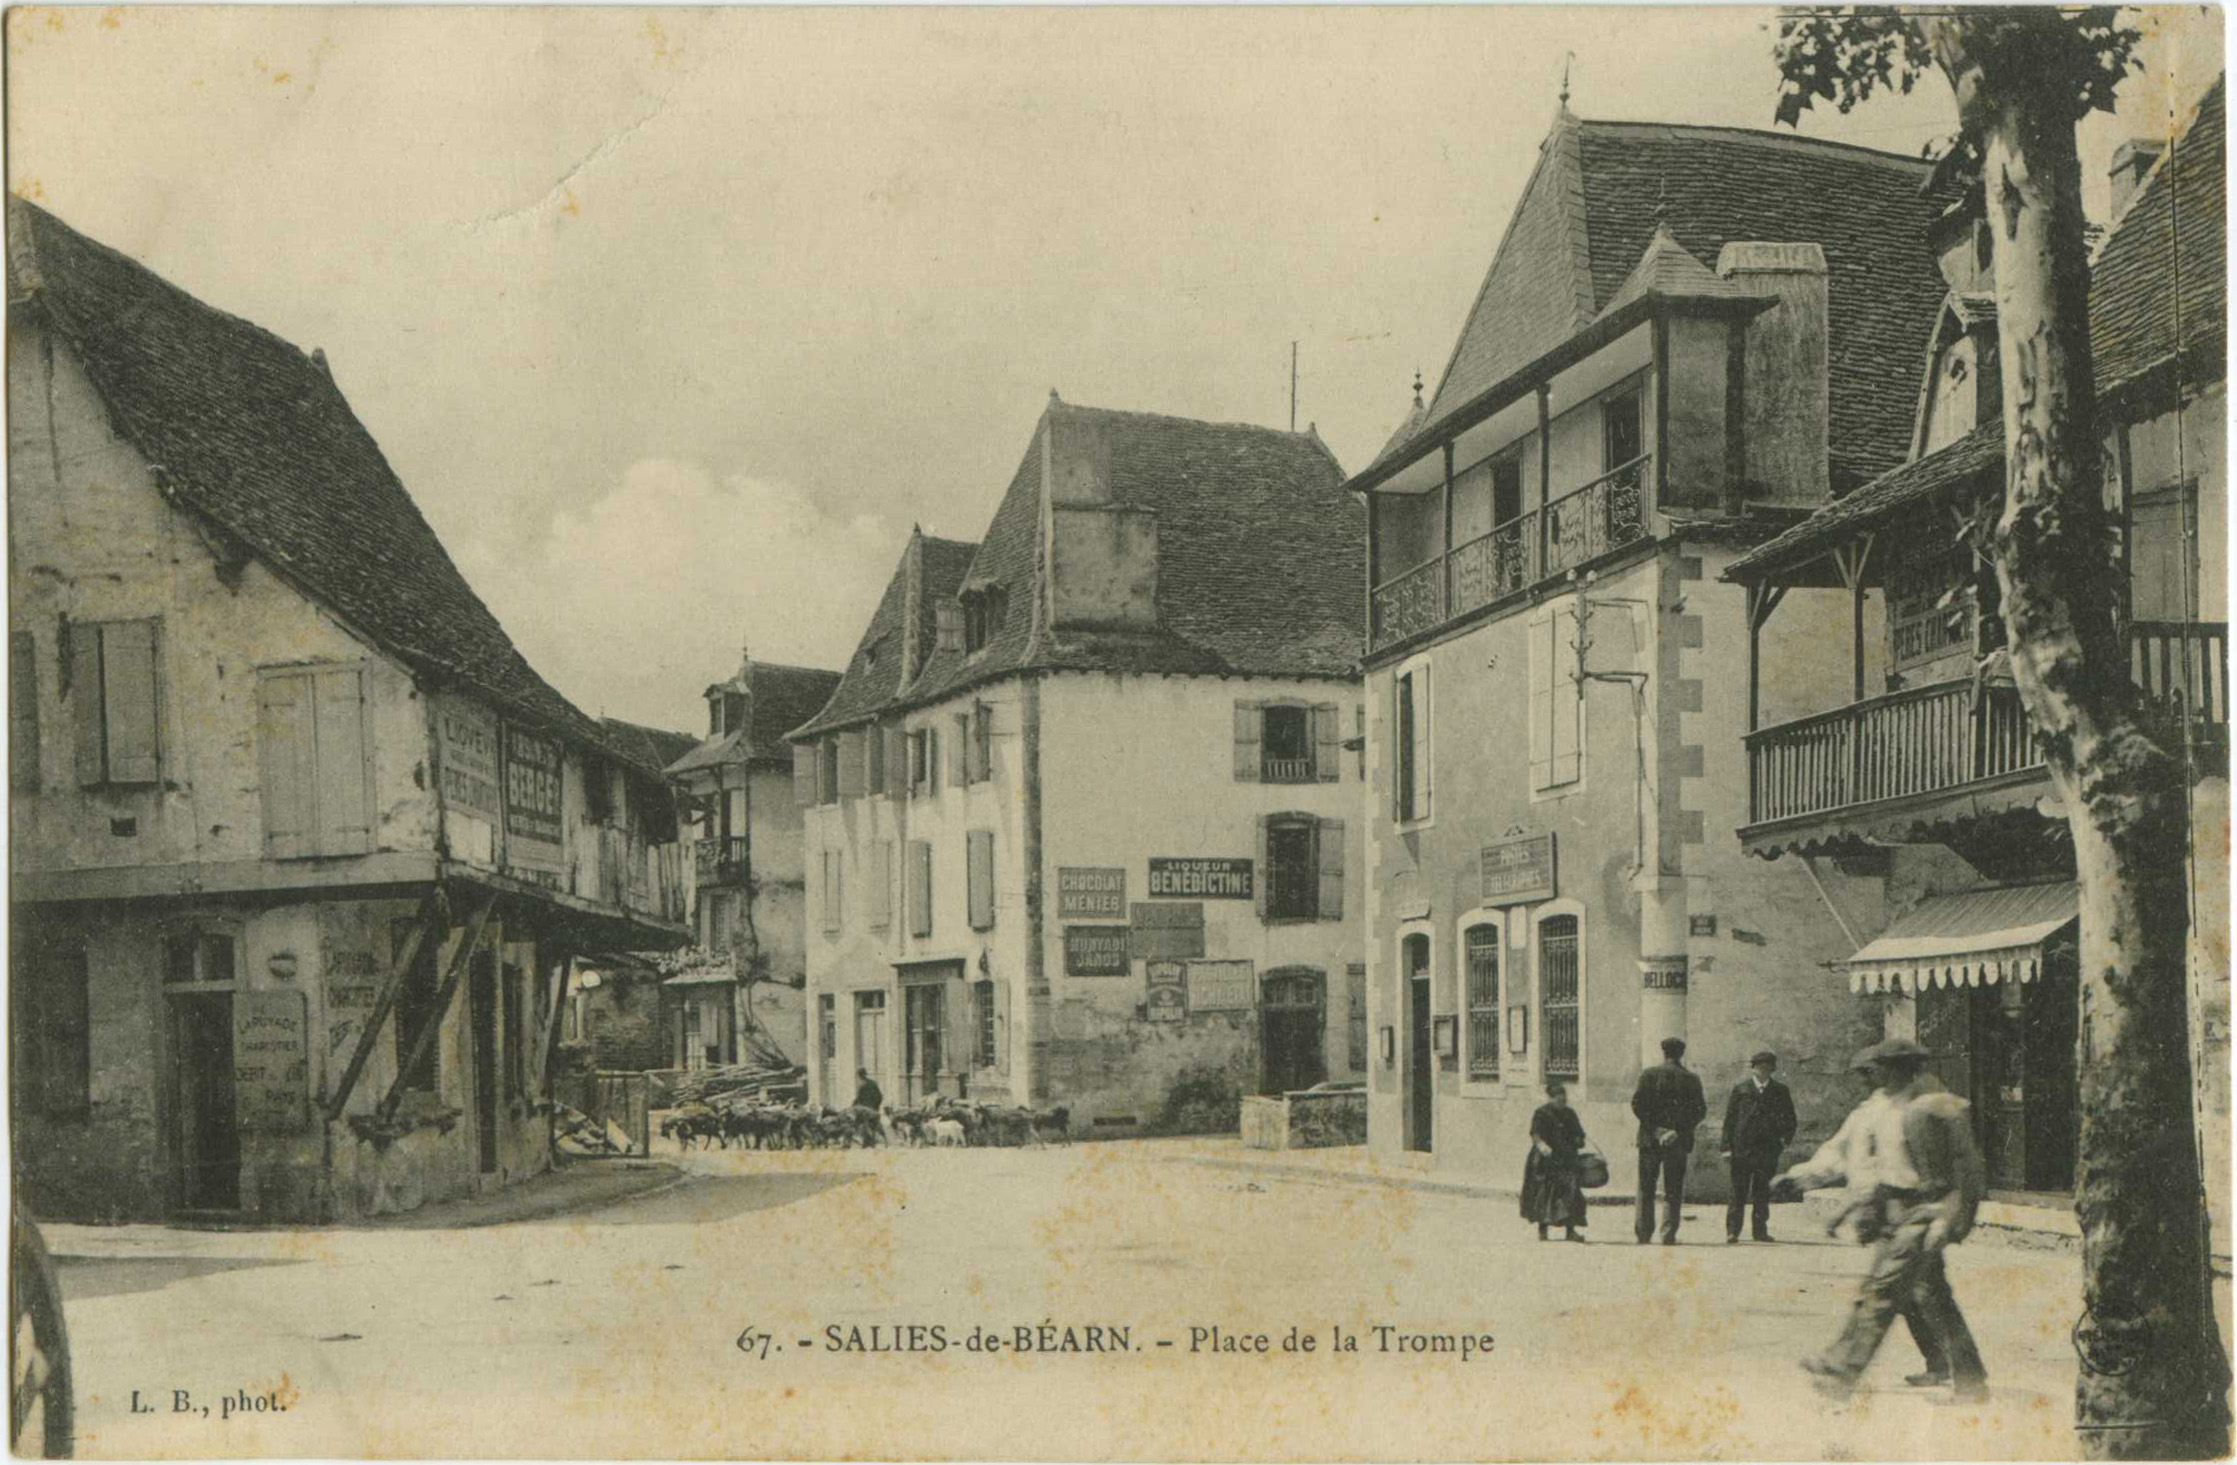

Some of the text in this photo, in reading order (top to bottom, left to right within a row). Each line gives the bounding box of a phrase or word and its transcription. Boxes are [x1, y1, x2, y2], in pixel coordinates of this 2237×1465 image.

[1167, 861, 1231, 872] LIQUEUR
[1062, 874, 1123, 891] CHOCOLAT
[1070, 937, 1126, 953] HUNYADI
